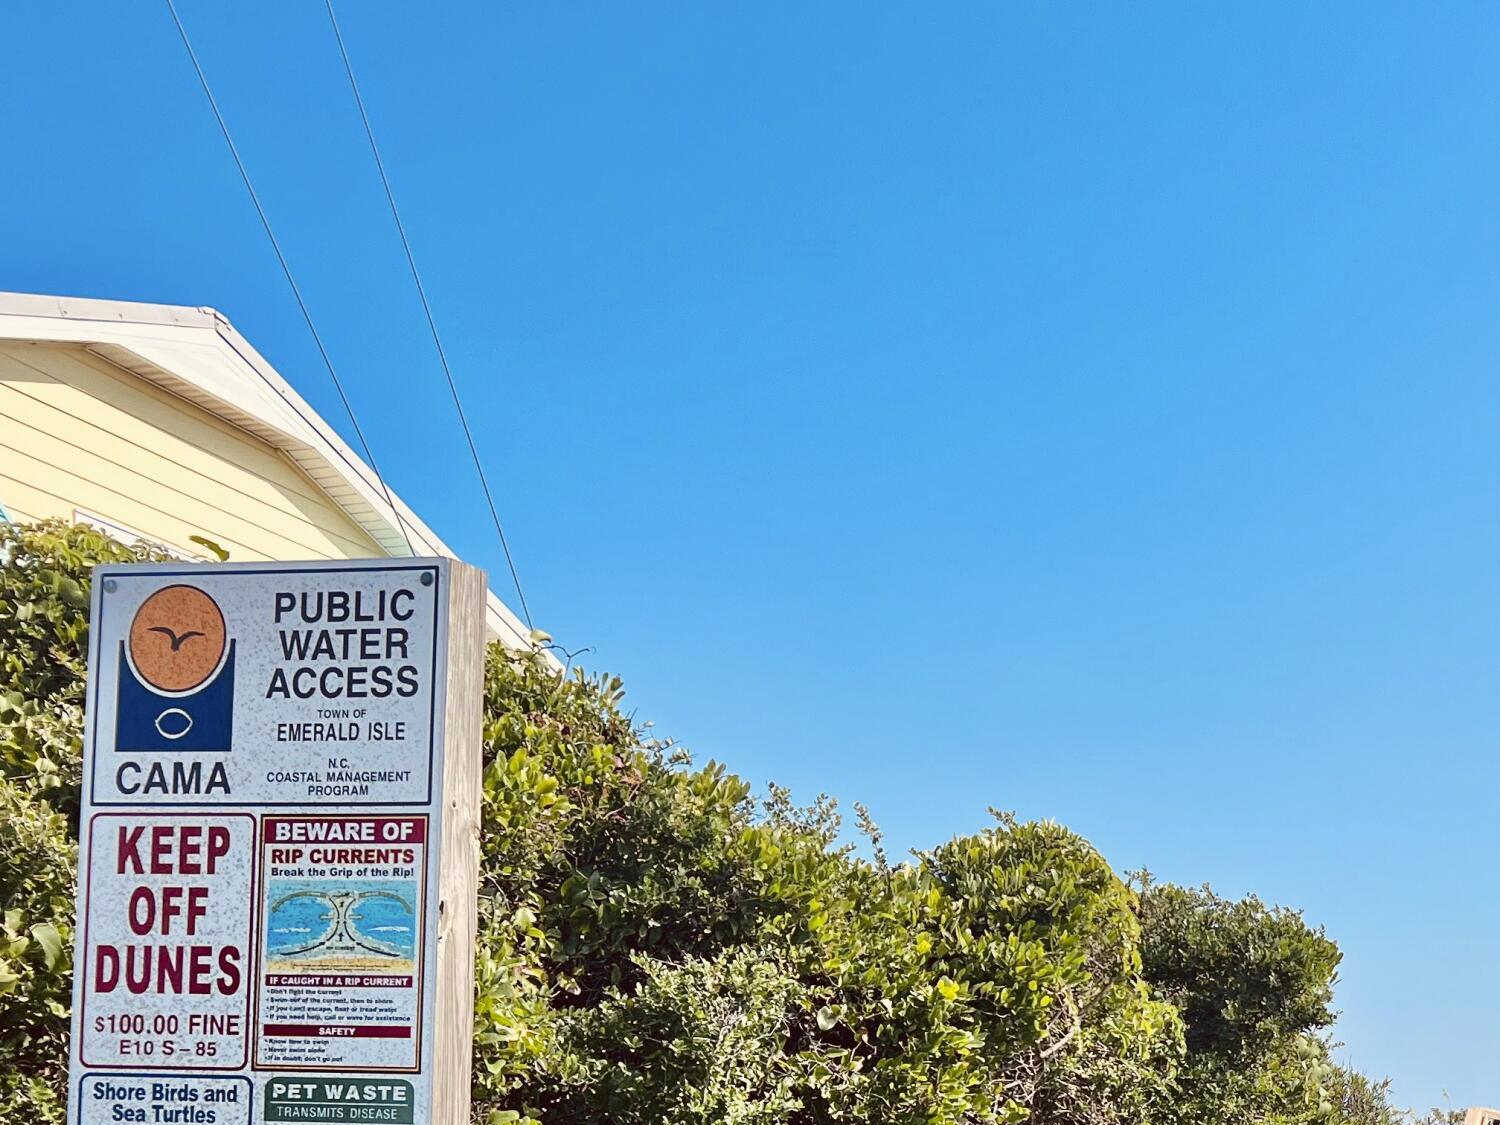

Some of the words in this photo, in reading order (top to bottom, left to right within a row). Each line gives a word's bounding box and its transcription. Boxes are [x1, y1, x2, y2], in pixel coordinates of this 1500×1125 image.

[274, 589, 415, 623] PUBLIC
[279, 628, 409, 661] WATER
[266, 666, 419, 699] ACCESS
[317, 709, 349, 718] TOWN
[353, 709, 366, 718] OF
[277, 723, 359, 741] EMERALD
[368, 722, 405, 740] ISLE
[116, 762, 231, 794] CAMA
[267, 772, 321, 782] COASTAL
[327, 771, 411, 781] MANAGEMENT
[308, 785, 368, 795] PROGRAM
[275, 822, 375, 841] BEWARE
[383, 822, 414, 840] OF
[117, 825, 230, 875] KEEP
[271, 849, 303, 863] RIP
[310, 849, 414, 864] CURRENTS
[271, 868, 304, 876] Break
[308, 868, 325, 876] the
[330, 868, 352, 878] Grip
[356, 868, 368, 876] of
[371, 868, 388, 876] the
[393, 868, 414, 878] Rip!
[128, 886, 207, 936] OFF
[95, 945, 241, 995] DUNES
[281, 977, 320, 985] CAUGHT
[323, 977, 333, 985] IN
[363, 978, 408, 986] CURRENT
[95, 1014, 178, 1034] $100.00
[189, 1015, 239, 1035] FINE
[120, 1040, 153, 1055] E10
[93, 1082, 146, 1100] Shore
[152, 1083, 198, 1101] Birds
[204, 1085, 237, 1102] and
[273, 1084, 317, 1099] PET
[325, 1085, 406, 1101] WASTE
[113, 1104, 146, 1122] Sea
[152, 1105, 215, 1123] Turtles
[277, 1107, 343, 1118] TRANSMITS
[350, 1108, 397, 1119] DISEASE
